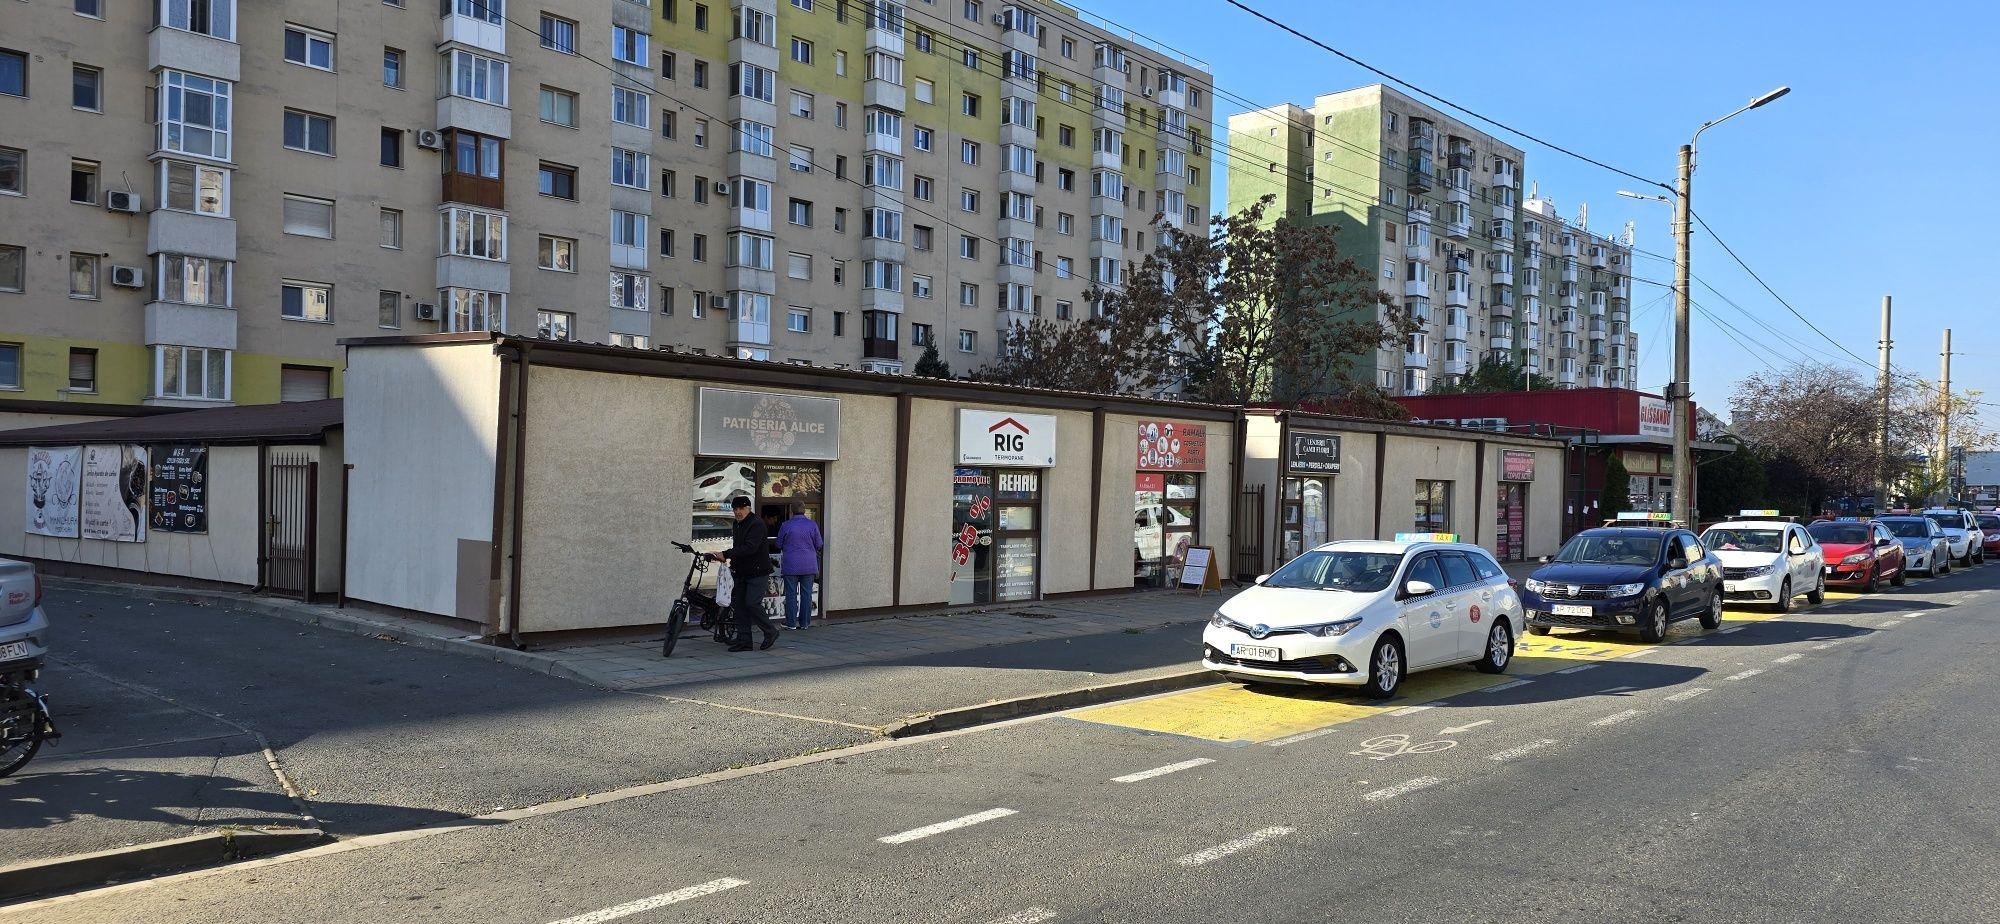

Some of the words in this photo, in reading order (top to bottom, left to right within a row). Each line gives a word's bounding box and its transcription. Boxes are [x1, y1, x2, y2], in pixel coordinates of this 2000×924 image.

[722, 417, 787, 431] PATISERIA
[790, 421, 825, 434] ALICE
[994, 434, 1024, 452] RIG
[998, 473, 1038, 492] REHAU
[7, 642, 26, 656] FLN
[1236, 646, 1246, 655] AR
[1249, 647, 1257, 656] 01
